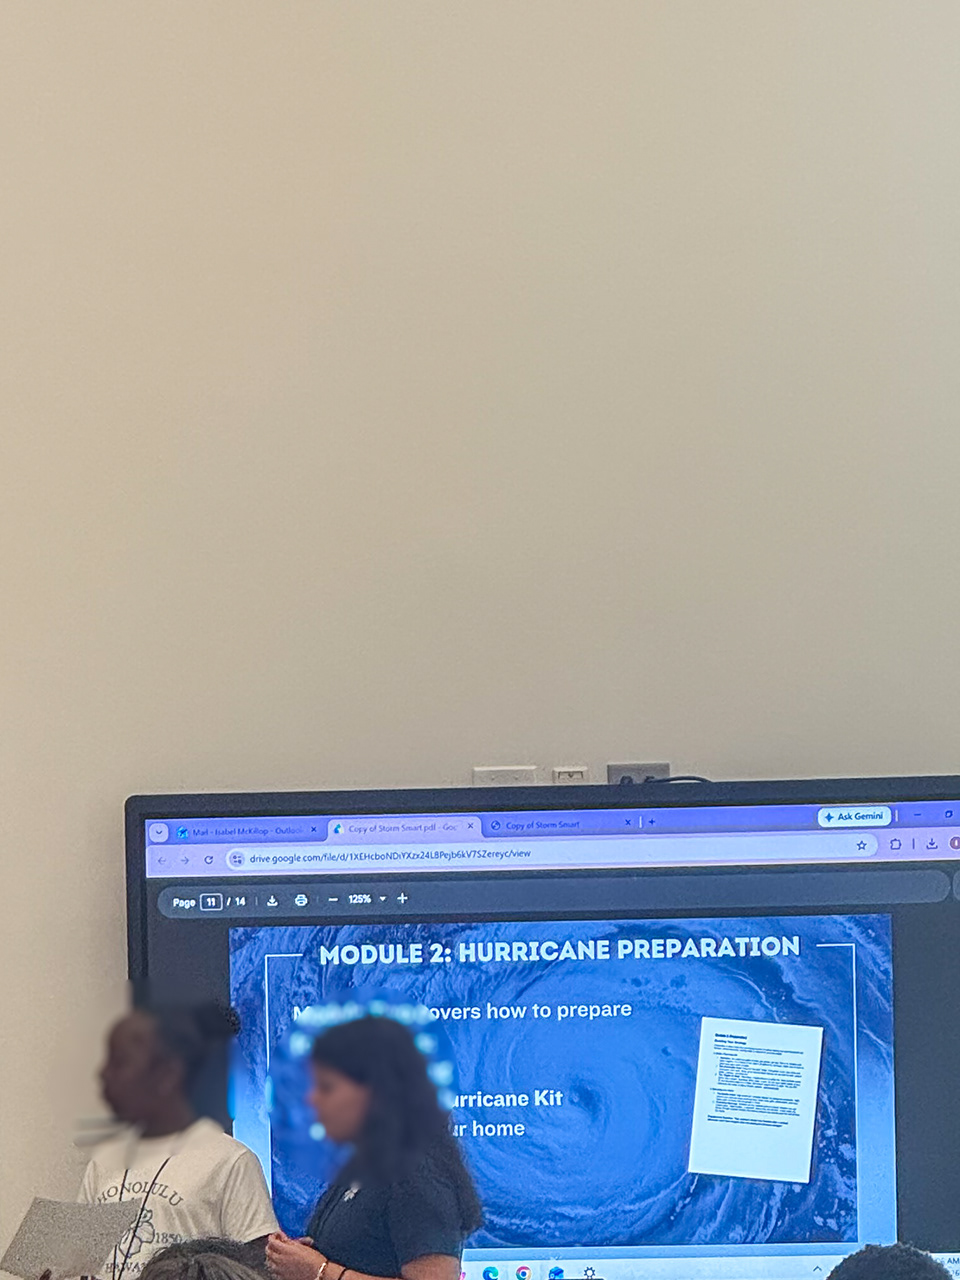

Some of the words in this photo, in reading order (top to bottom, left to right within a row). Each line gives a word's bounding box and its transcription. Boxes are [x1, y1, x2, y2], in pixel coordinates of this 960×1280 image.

[838, 812, 853, 821] Ask
[854, 811, 884, 821] Gemini
[215, 826, 237, 836] Isabel
[348, 825, 368, 835] Copy
[369, 824, 378, 833] of
[379, 824, 400, 833] Storm
[506, 821, 525, 831] Copy
[526, 820, 535, 829] of
[535, 820, 557, 829] Storm
[558, 820, 580, 829] Smart
[173, 898, 196, 909] Page
[206, 897, 217, 907] 11
[235, 896, 246, 907] 14
[348, 894, 372, 904] 125%
[320, 943, 423, 965] MODULE
[429, 943, 452, 963] 2:
[459, 939, 611, 963] HURRICANE
[617, 935, 801, 959] PREPARATION
[429, 1005, 481, 1021] overs
[487, 1003, 527, 1019] how
[531, 1003, 552, 1019] to
[557, 1003, 633, 1022] prepare
[534, 1089, 564, 1107] Kit
[472, 1120, 526, 1137] home
[97, 1181, 185, 1207] HONOLULU
